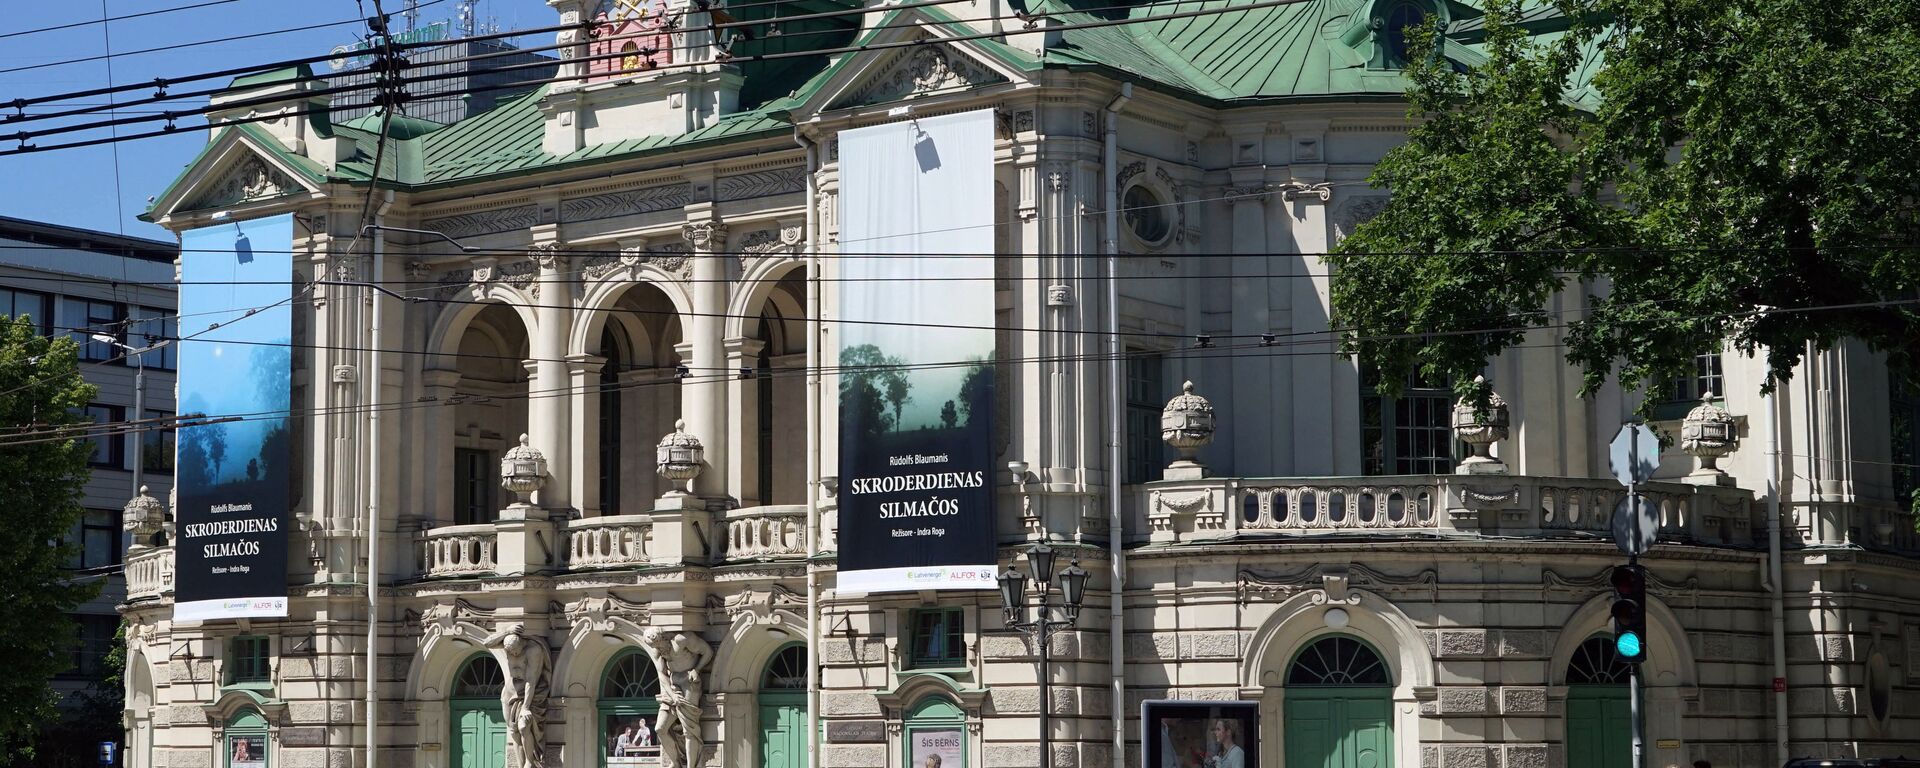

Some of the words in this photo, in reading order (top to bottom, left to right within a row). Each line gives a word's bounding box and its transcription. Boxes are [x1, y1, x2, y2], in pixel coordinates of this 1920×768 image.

[889, 454, 914, 466] Rūdolfs
[914, 452, 949, 464] Blaumanis
[851, 471, 983, 495] SKRODERDIENAS
[228, 502, 252, 513] Blaumanis
[879, 496, 959, 519] SILMAČOS
[185, 518, 277, 538] SKRODERDIENAS
[917, 527, 931, 536] Indra
[931, 526, 945, 537] Roga
[204, 538, 259, 558] SILMAČOS
